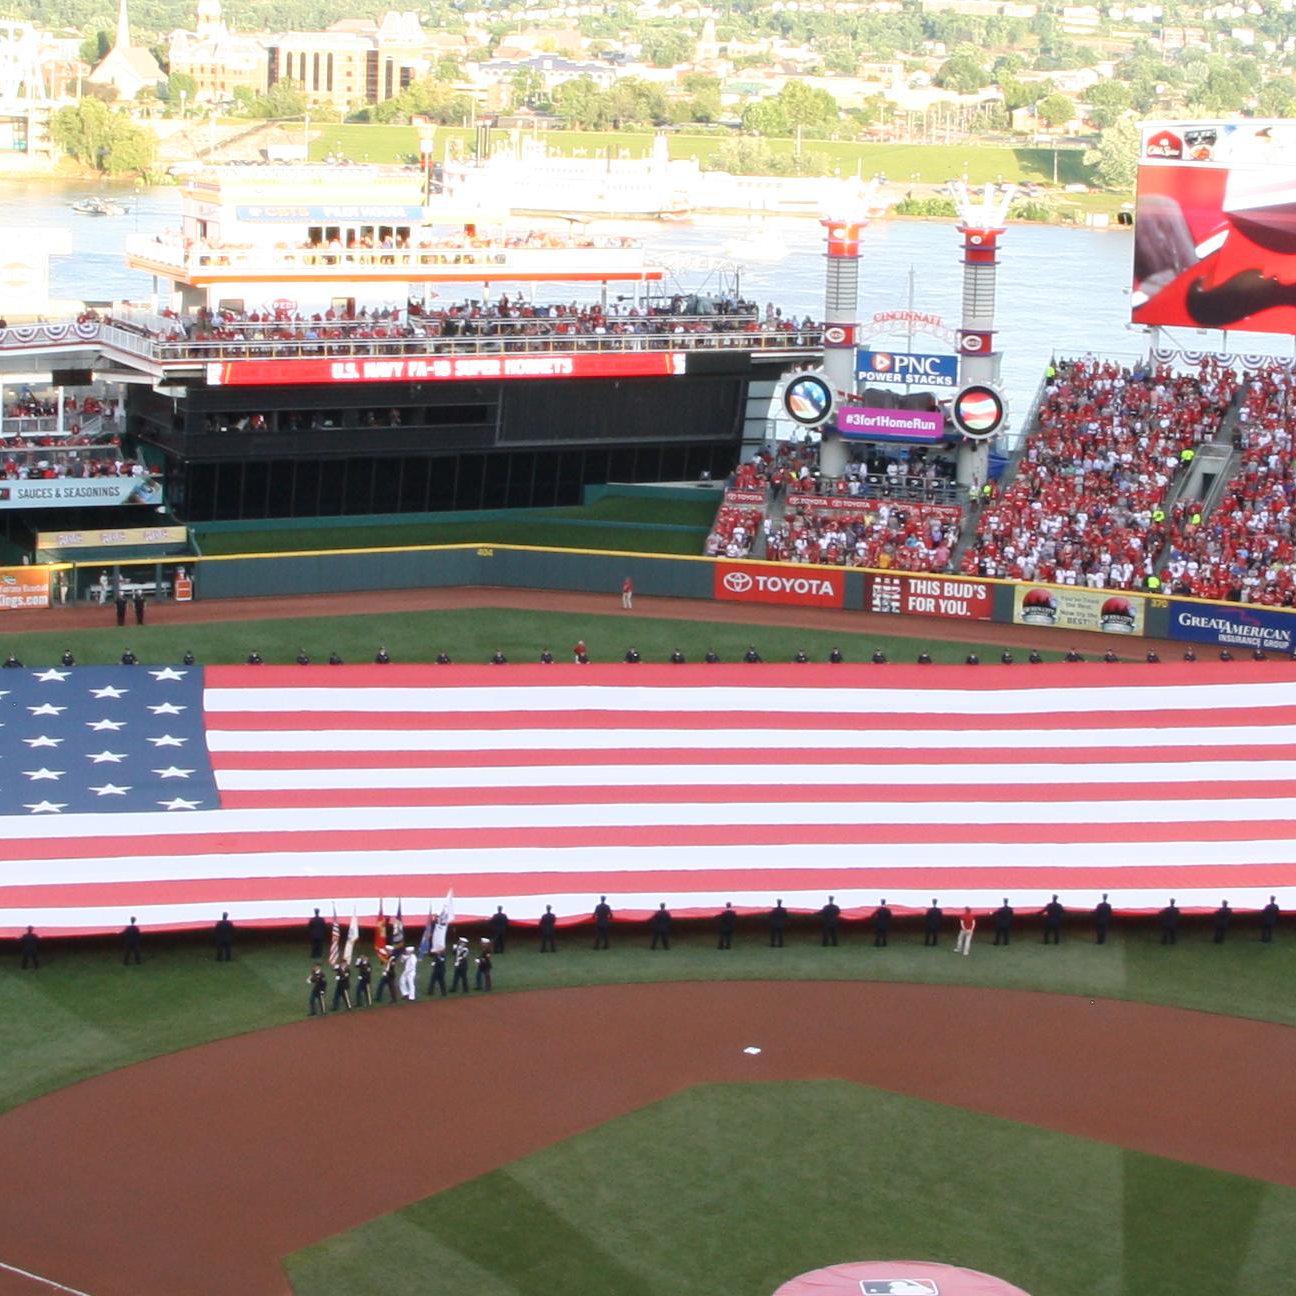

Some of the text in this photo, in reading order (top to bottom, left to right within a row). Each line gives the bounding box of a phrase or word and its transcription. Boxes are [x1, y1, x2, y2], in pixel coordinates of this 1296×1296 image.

[331, 362, 360, 378] U.S.
[894, 356, 941, 376] PNC
[858, 371, 953, 385] POWER STACKS
[17, 485, 121, 499] SAUCES & SEASONINGS
[755, 575, 834, 597] TOYOTA
[908, 579, 987, 600] THIS BUD'S
[908, 597, 972, 616] FOR YOU.
[1218, 634, 1290, 649] INSURANCE GROUP
